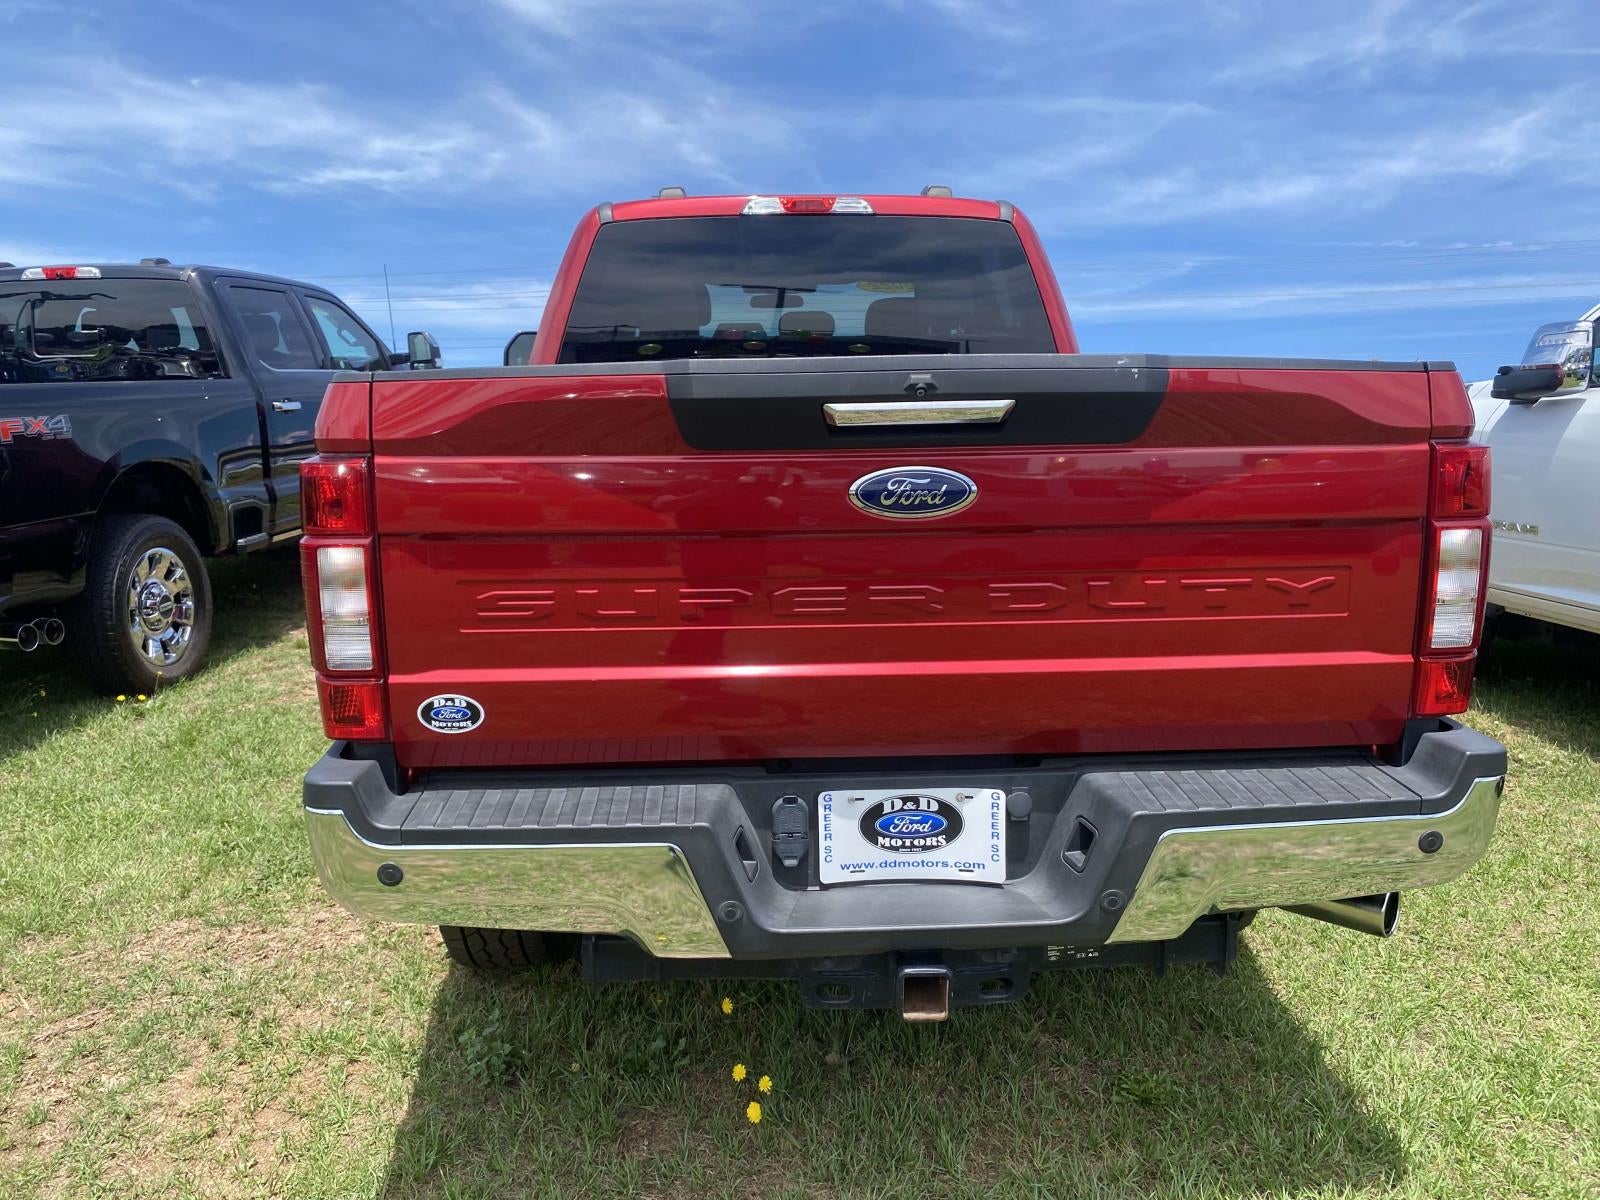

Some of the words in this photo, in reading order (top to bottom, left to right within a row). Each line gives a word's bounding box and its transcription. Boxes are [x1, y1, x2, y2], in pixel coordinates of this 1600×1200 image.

[0, 415, 72, 444] FX4
[880, 477, 948, 506] Ford
[476, 586, 944, 621] SUPER
[988, 576, 1336, 612] DUTY
[433, 698, 467, 708] D&D
[438, 709, 463, 719] Ford
[431, 720, 472, 728] MOTORS
[881, 797, 939, 814] D&D
[823, 793, 833, 841] GREER
[889, 816, 932, 832] Ford
[990, 792, 1000, 841] GREER
[877, 834, 947, 847] MOTORS
[824, 845, 833, 863] SC
[990, 844, 1000, 862] SC
[839, 859, 986, 871] www.ddmotors.com
